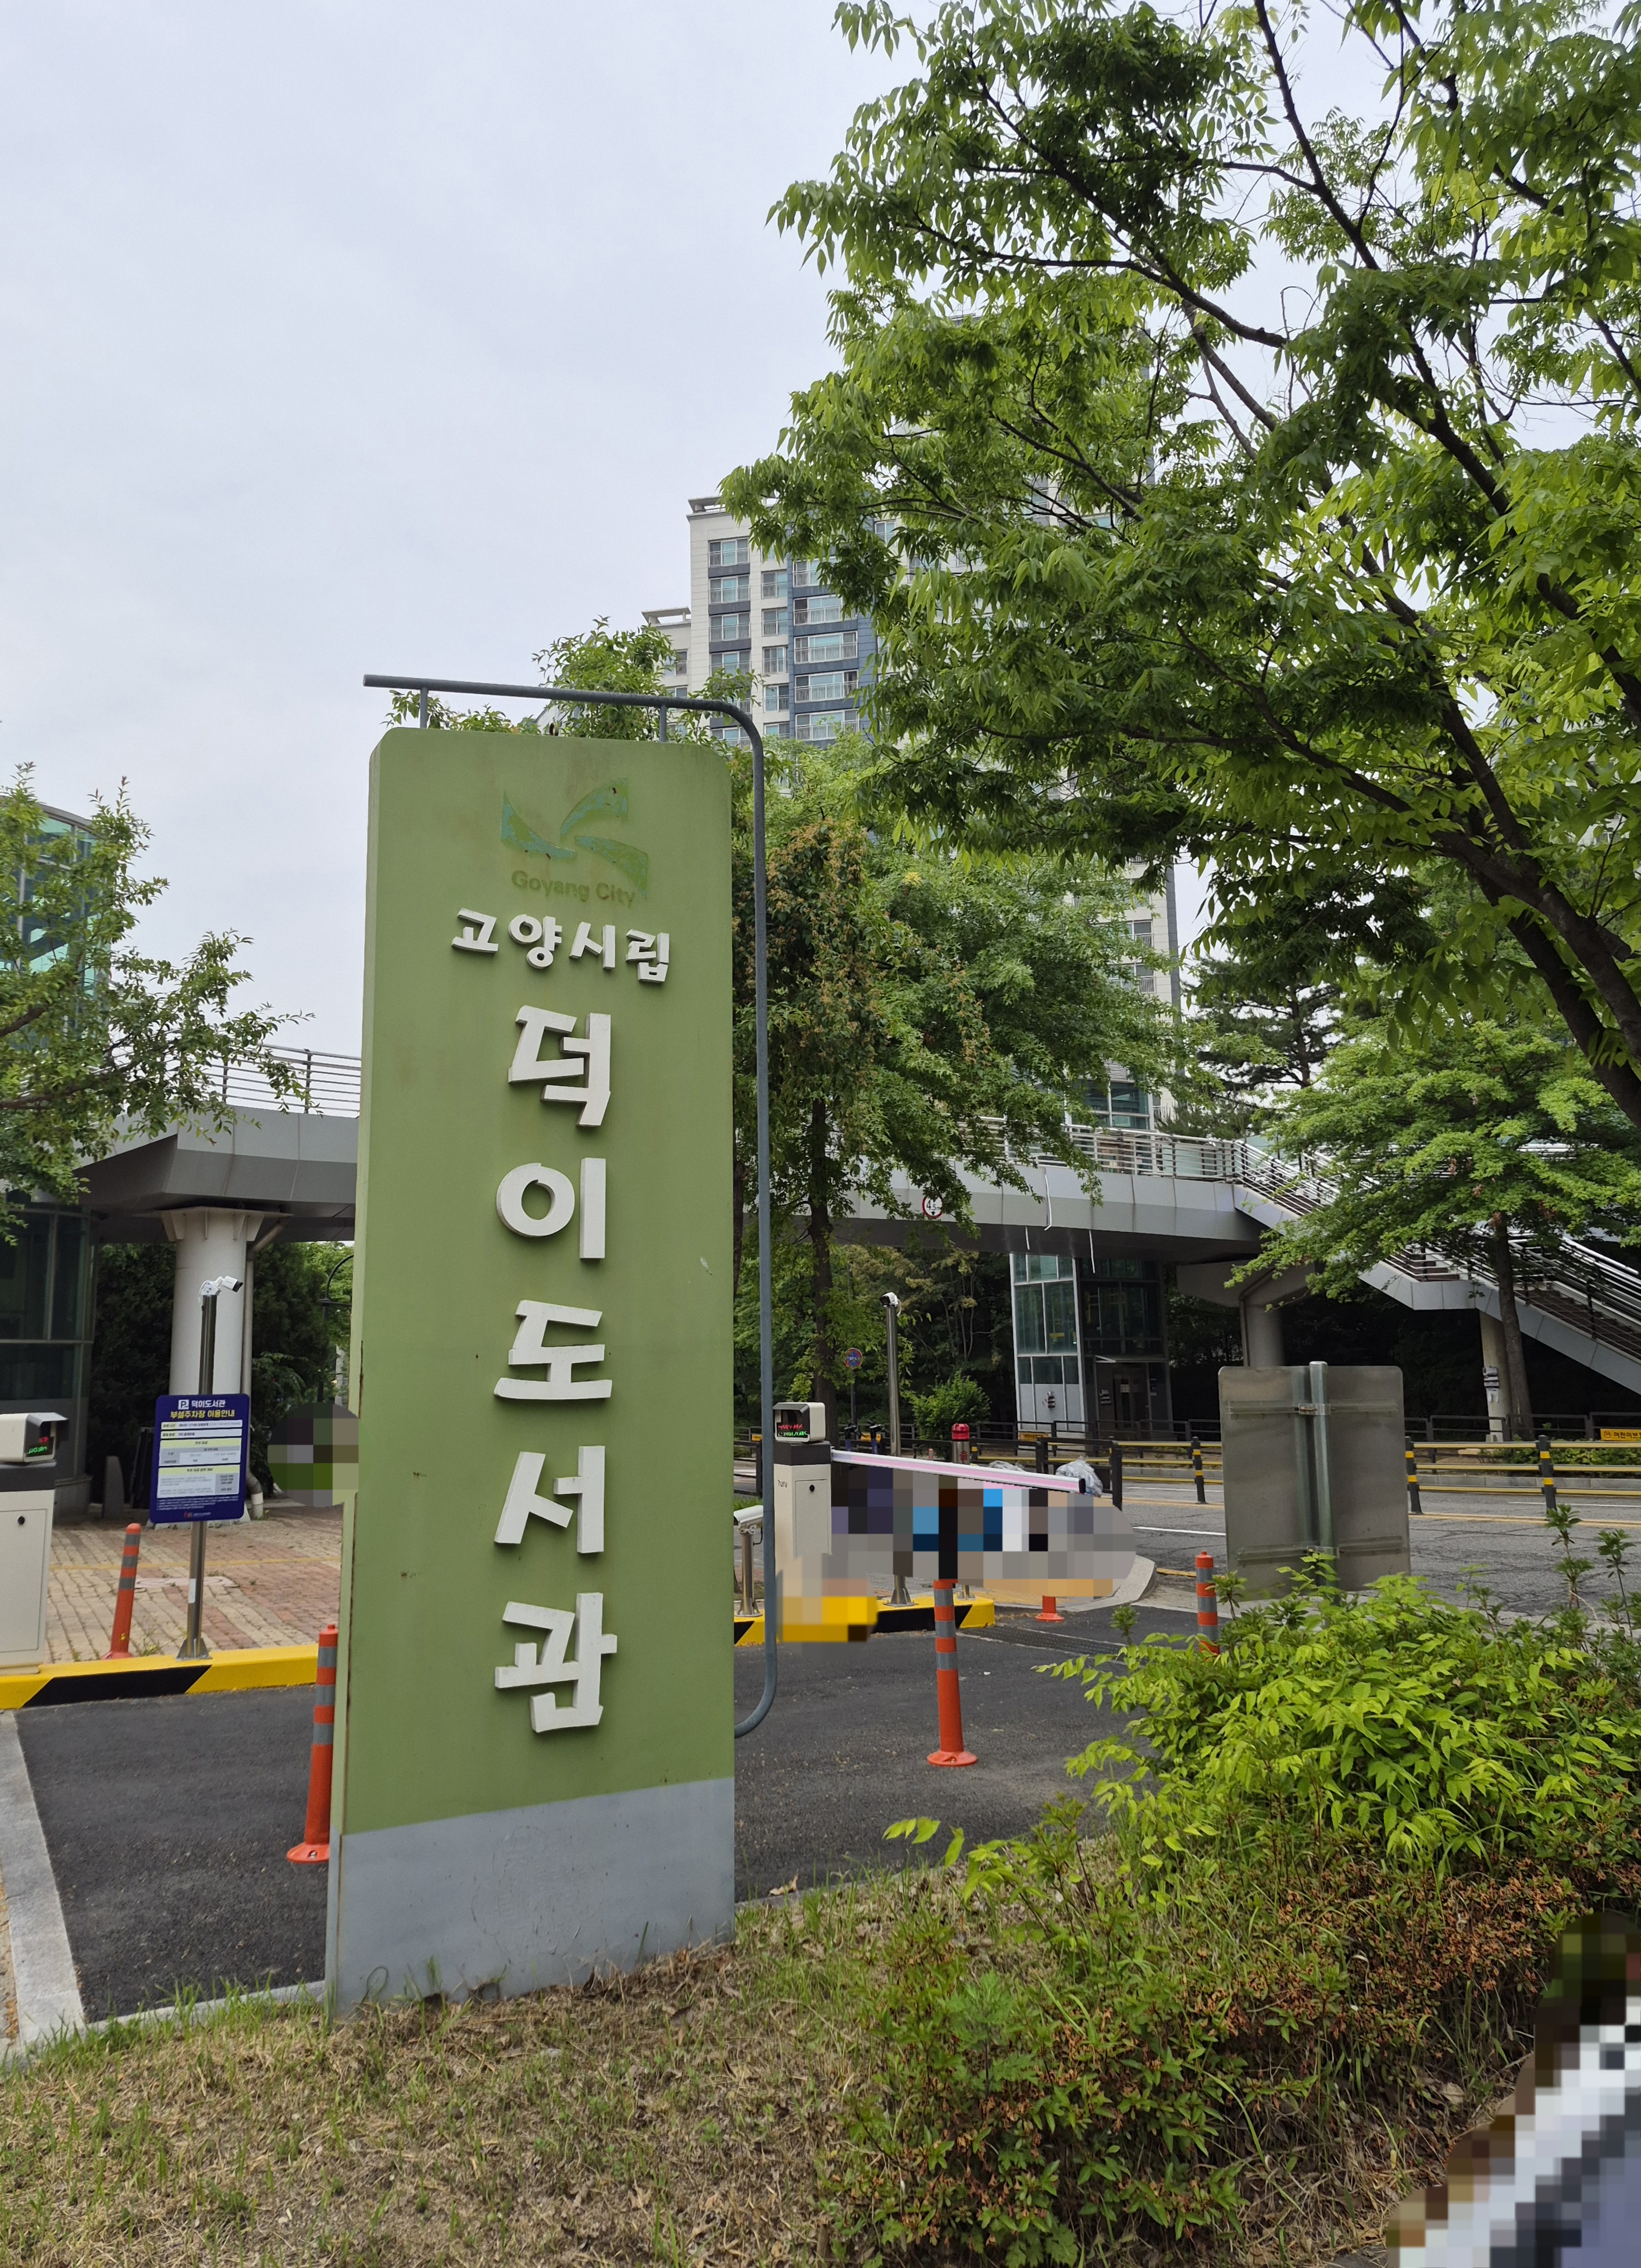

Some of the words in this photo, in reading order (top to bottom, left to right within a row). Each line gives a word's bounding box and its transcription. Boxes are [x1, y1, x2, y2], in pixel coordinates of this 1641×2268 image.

[511, 870, 590, 902] Goyang
[596, 882, 636, 909] City
[452, 907, 670, 983] 고양시립
[493, 1005, 618, 1733] 덕이도서관
[170, 1410, 206, 1419] 부설주차장
[208, 1409, 235, 1418] 이용안내
[191, 1400, 226, 1408] 덕이도서관
